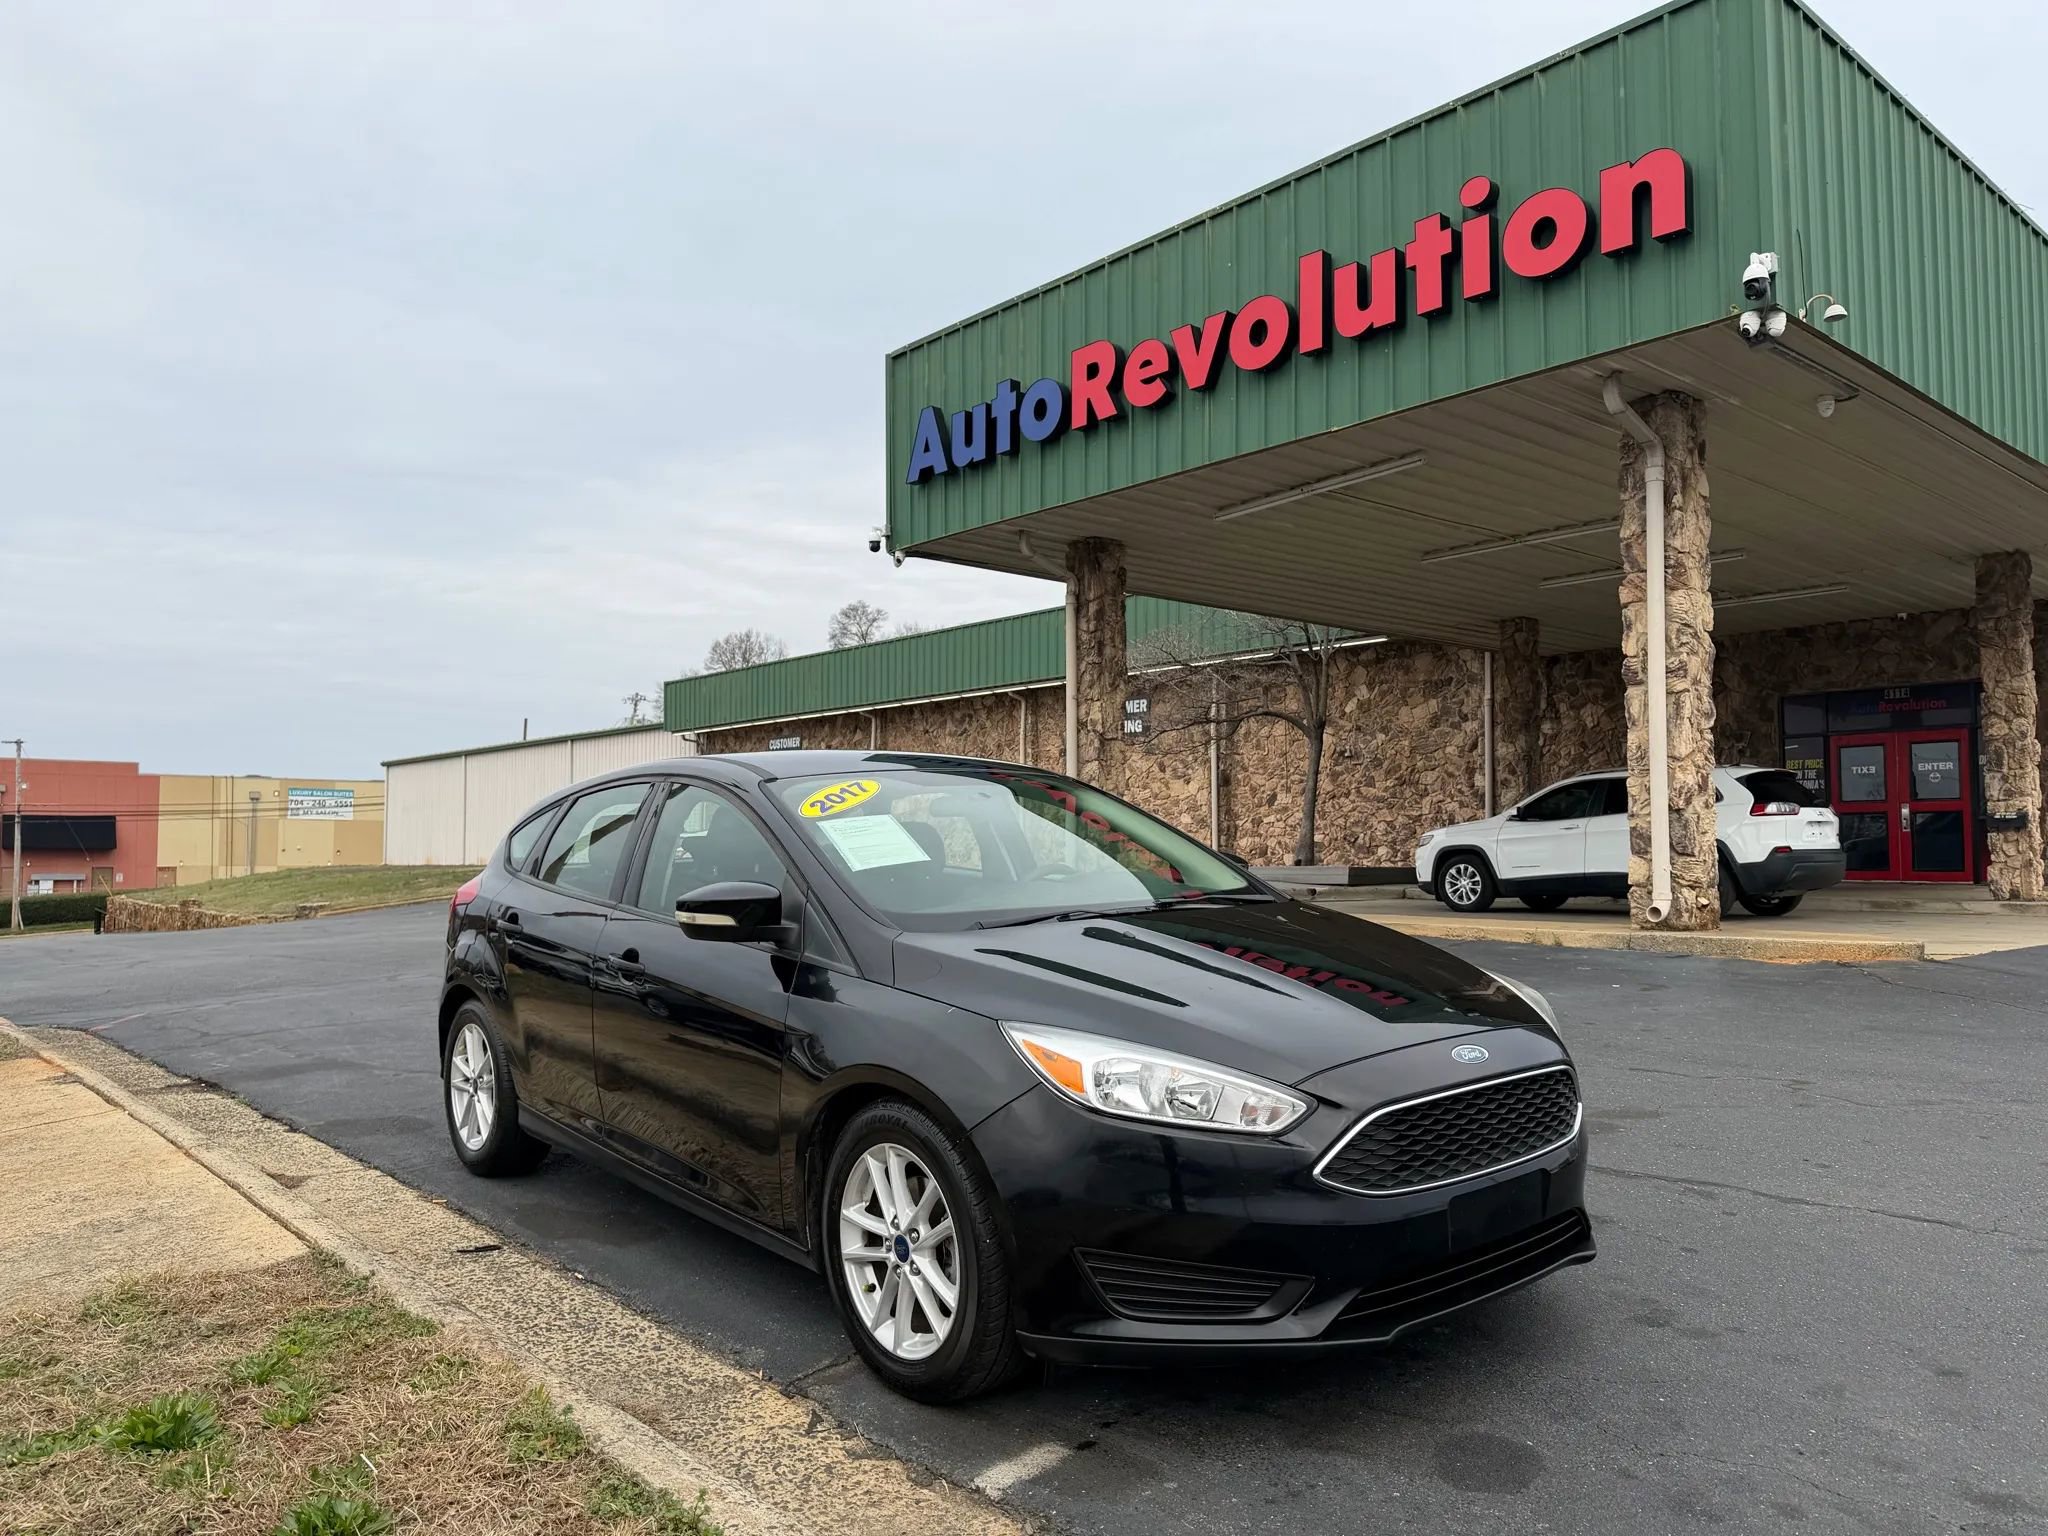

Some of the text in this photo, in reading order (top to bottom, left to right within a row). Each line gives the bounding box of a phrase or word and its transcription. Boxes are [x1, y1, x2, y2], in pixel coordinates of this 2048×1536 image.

[906, 147, 1692, 485] AutoRevolution
[769, 737, 800, 750] CUSTOMER
[1786, 759, 1824, 769] BEST PRICE
[1918, 762, 1953, 771] ENTER
[1804, 769, 1817, 779] THE
[809, 782, 869, 814] 2017
[1459, 1048, 1482, 1060] Ford
